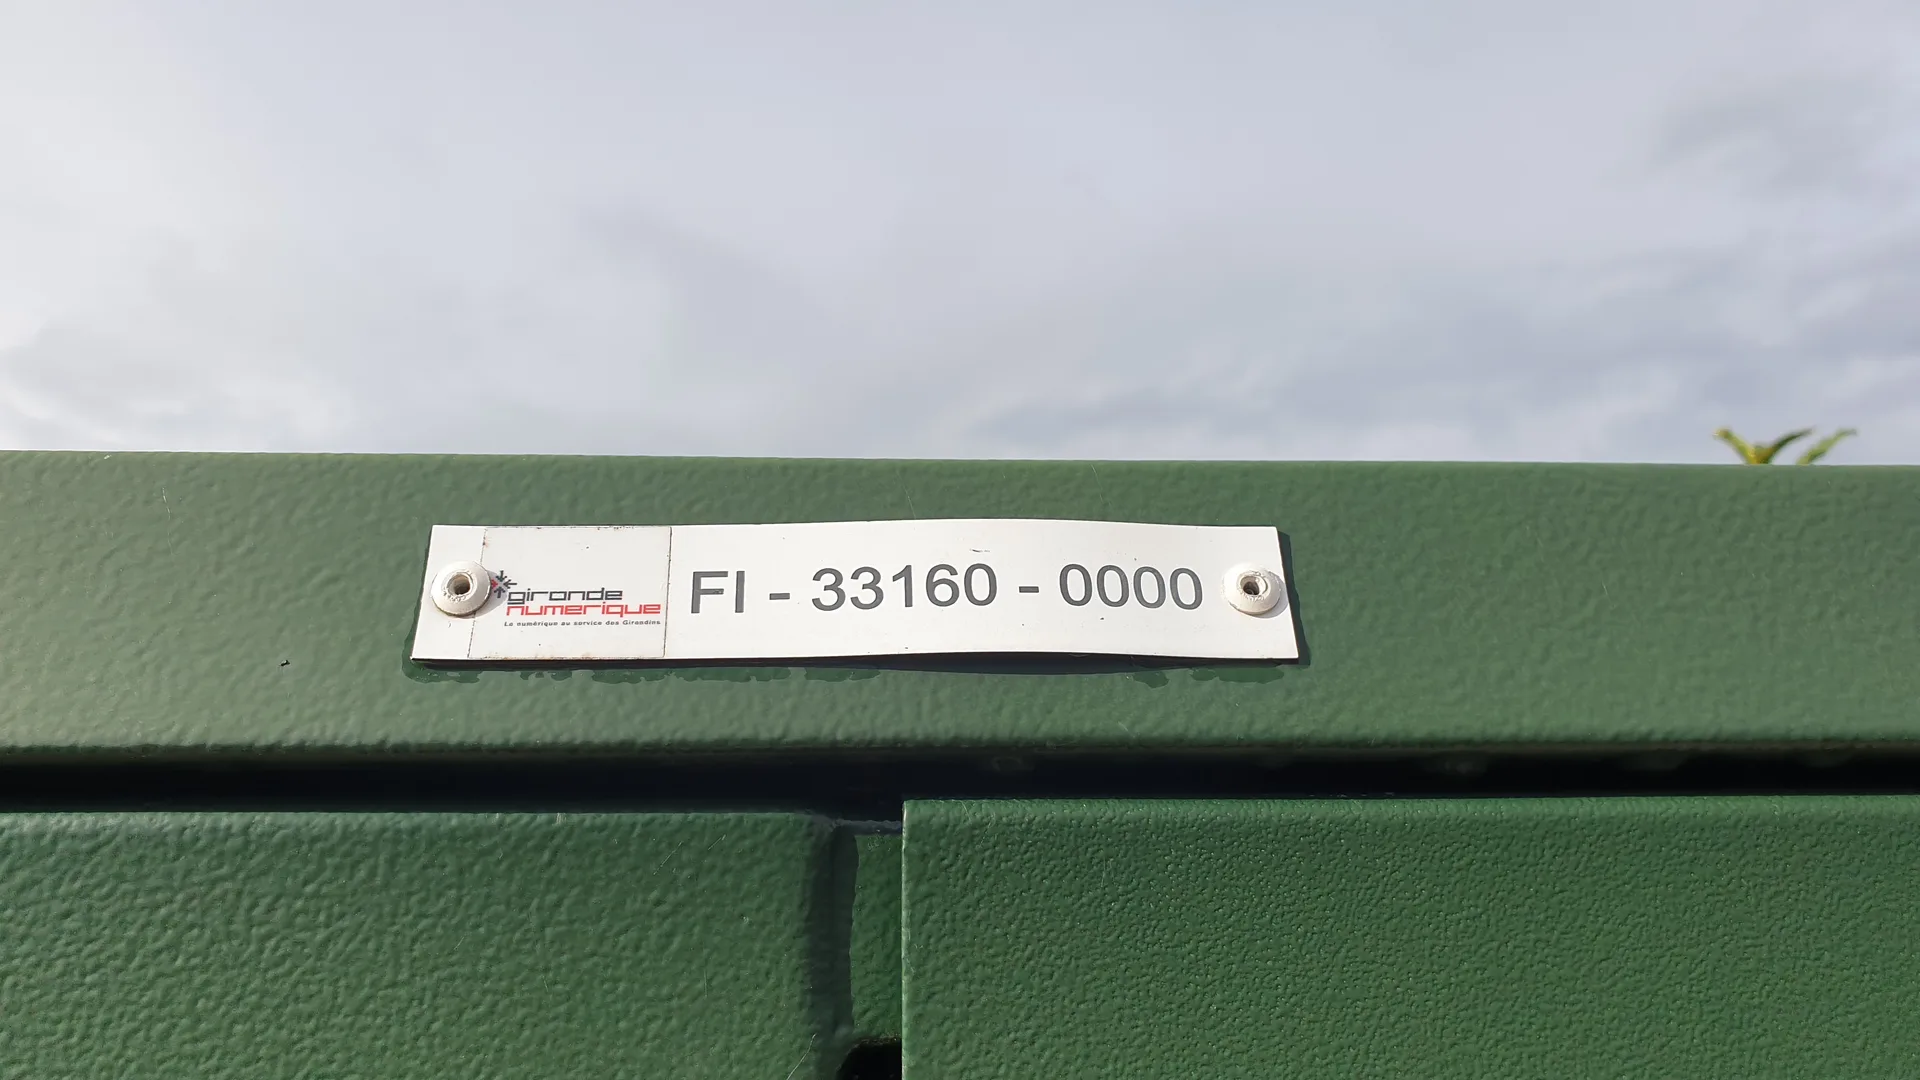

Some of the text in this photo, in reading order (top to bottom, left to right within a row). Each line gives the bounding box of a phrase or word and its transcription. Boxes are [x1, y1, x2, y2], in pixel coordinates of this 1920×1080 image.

[507, 587, 623, 605] gironde
[690, 563, 1203, 614] FI - 33160 - 0000
